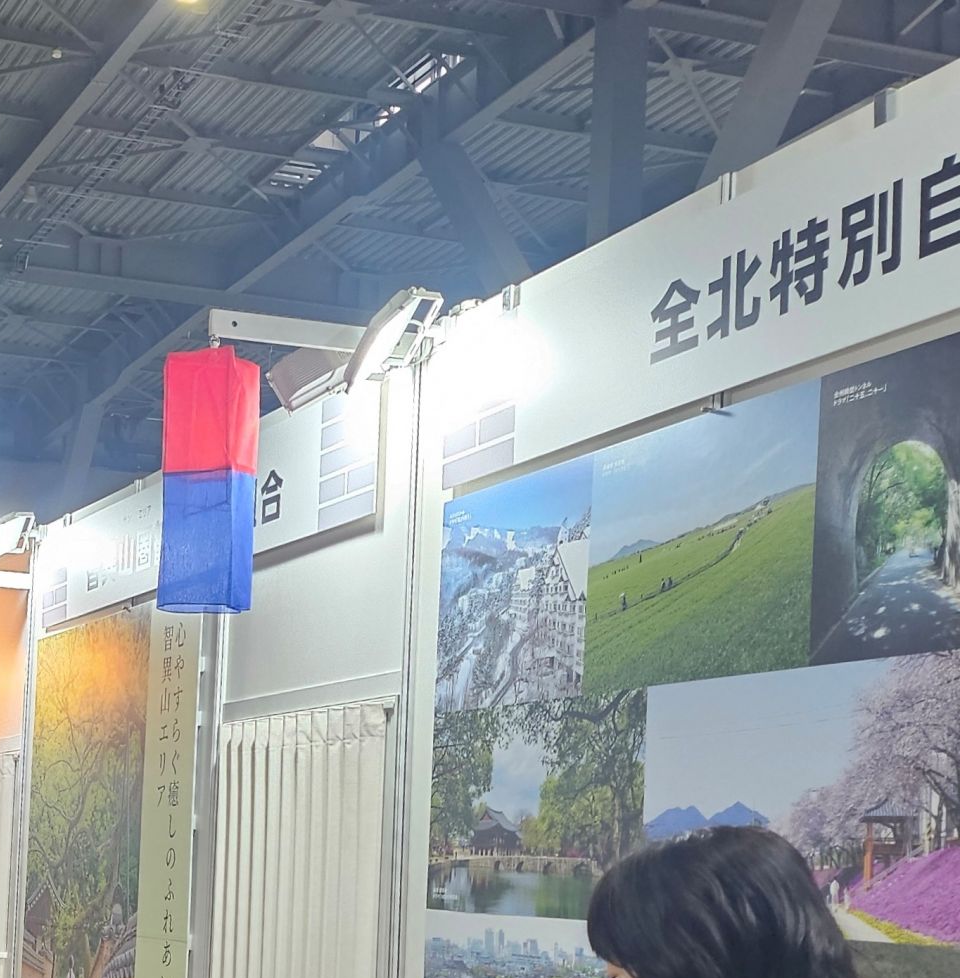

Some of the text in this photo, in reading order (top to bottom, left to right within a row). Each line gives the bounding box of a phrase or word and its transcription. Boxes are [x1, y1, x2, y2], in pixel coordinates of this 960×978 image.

[157, 626, 174, 808] 智異山エリア
